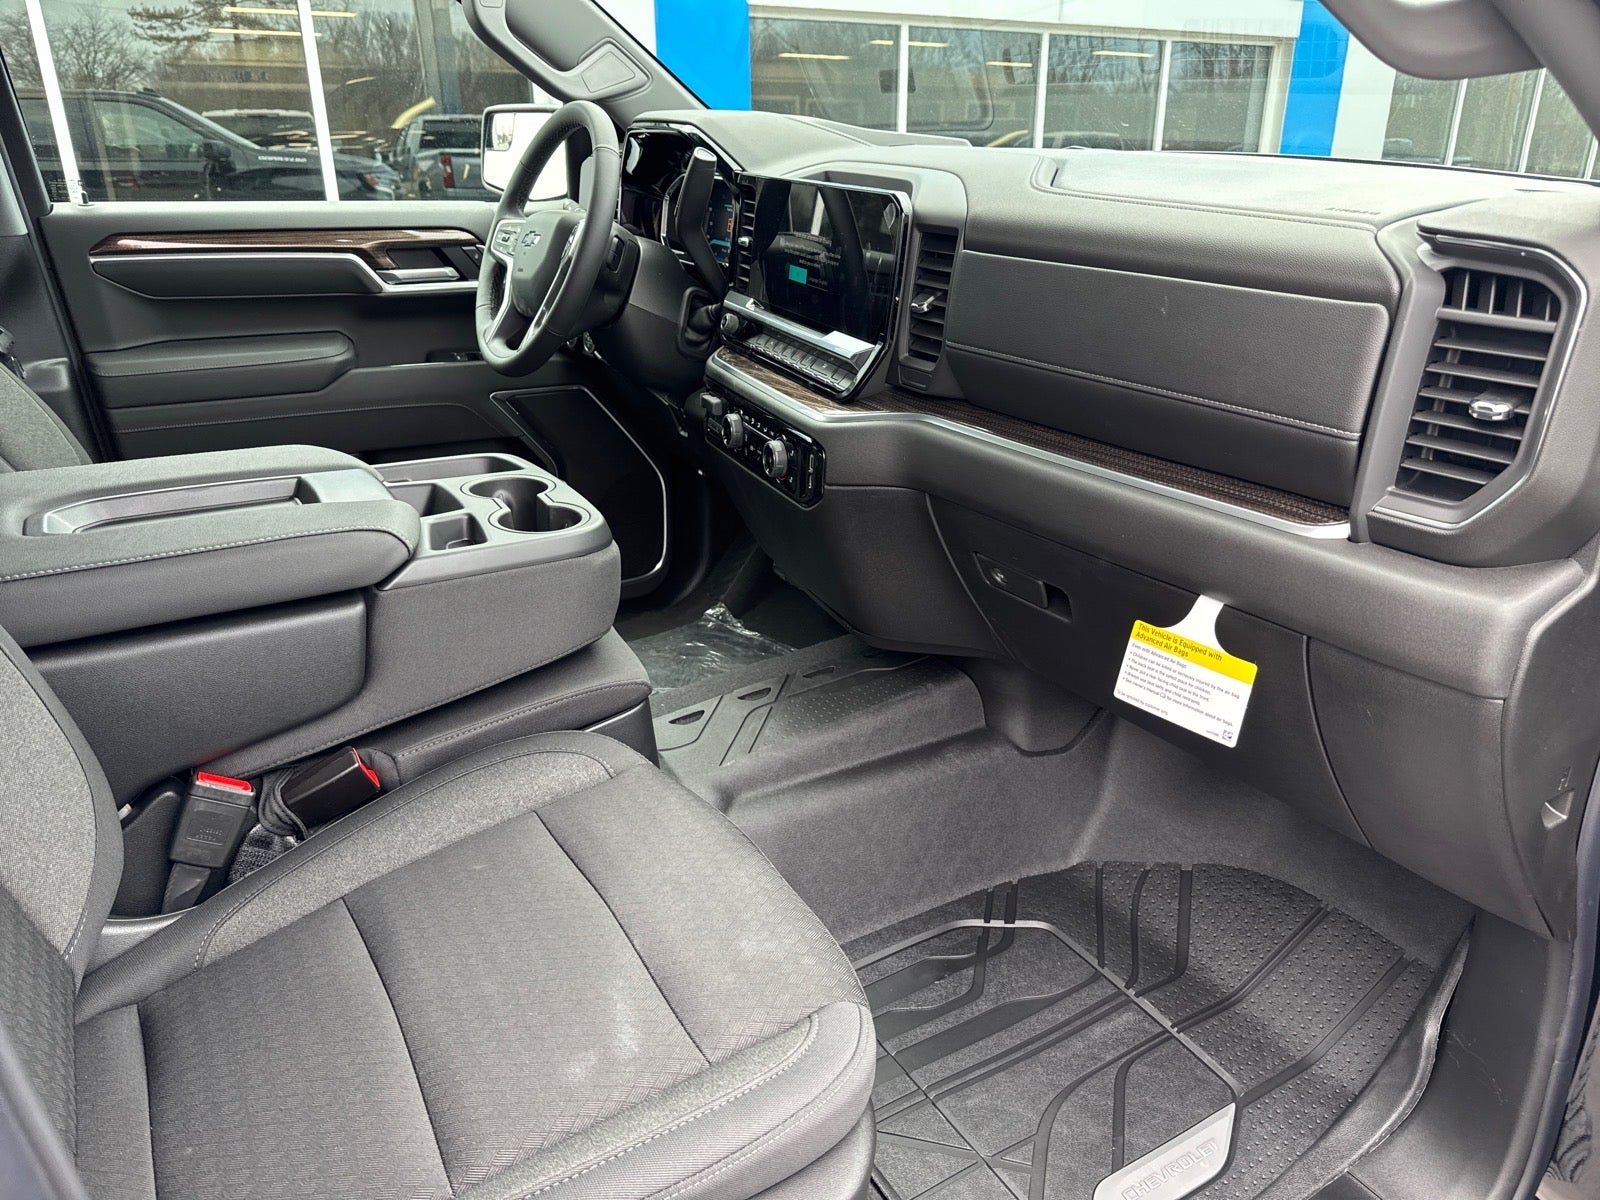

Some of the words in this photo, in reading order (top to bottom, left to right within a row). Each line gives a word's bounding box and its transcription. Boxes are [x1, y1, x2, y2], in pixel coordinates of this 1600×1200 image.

[1135, 631, 1163, 646] Advanced
[1163, 642, 1172, 650] Air
[1173, 646, 1189, 658] Bags
[1138, 623, 1150, 632] This
[1150, 628, 1171, 641] Vehicle
[1172, 636, 1178, 644] is
[1178, 639, 1207, 656] Equipped
[1207, 651, 1222, 661] with
[1121, 1137, 1218, 1200] CHEVROLET
